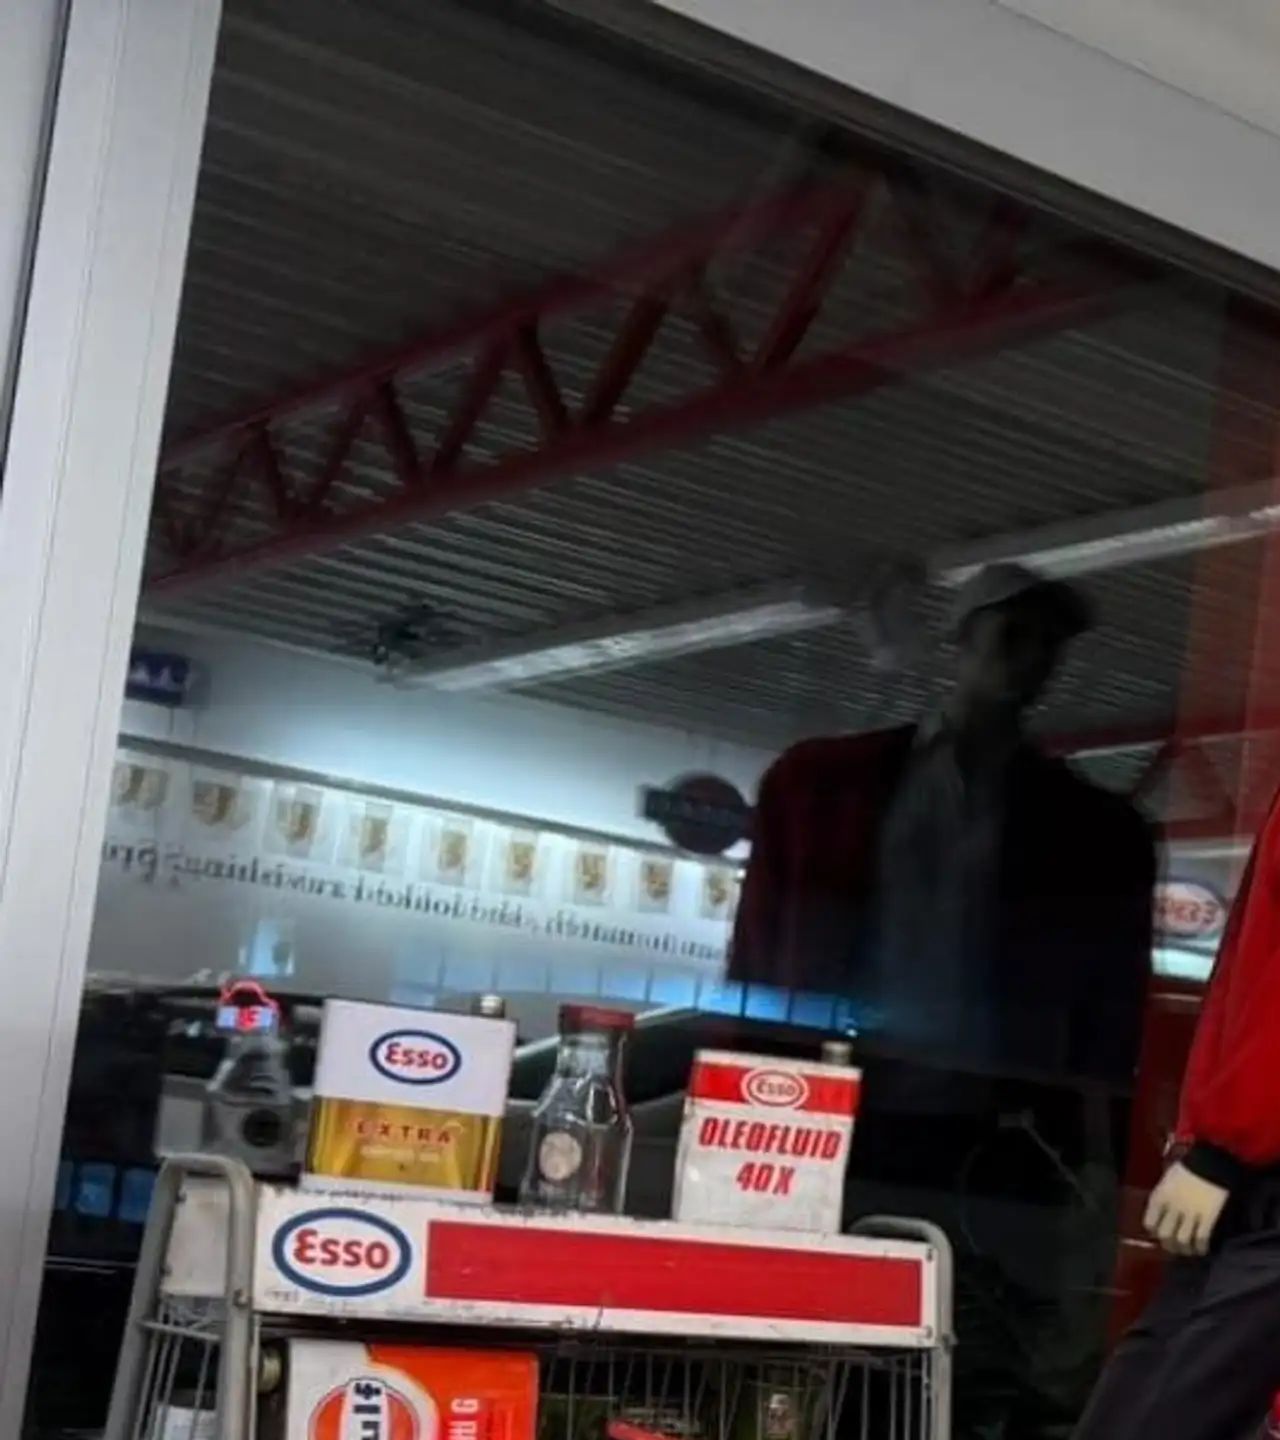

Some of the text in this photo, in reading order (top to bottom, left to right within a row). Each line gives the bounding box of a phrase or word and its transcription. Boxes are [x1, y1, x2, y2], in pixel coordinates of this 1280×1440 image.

[384, 1041, 450, 1071] Esso
[755, 1077, 798, 1097] Esso
[355, 1119, 452, 1144] EXTRA
[699, 1116, 844, 1161] OLEOFLUID
[293, 1227, 391, 1270] Esso
